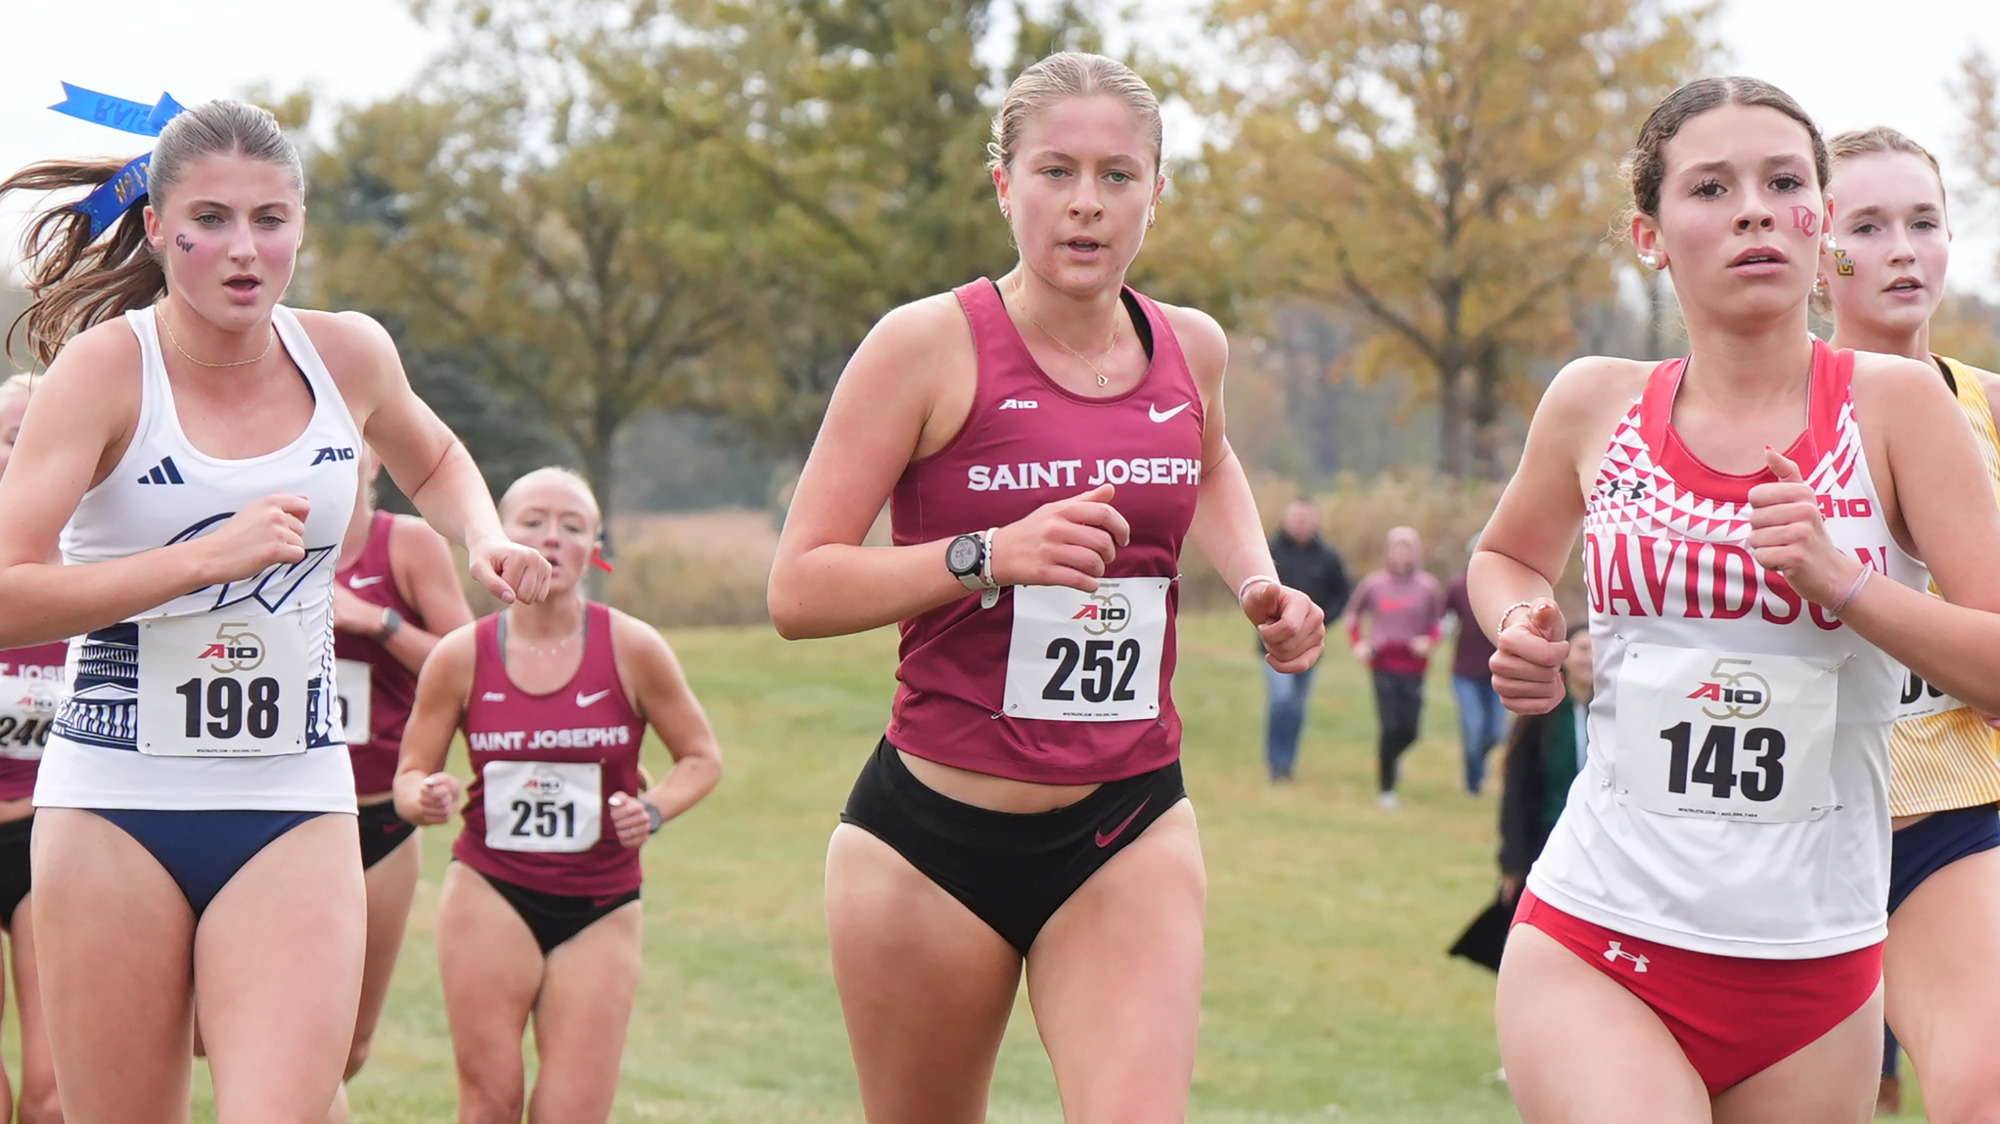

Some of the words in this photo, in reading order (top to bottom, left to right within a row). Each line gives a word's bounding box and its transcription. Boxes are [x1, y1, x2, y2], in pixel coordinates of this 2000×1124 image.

[999, 399, 1038, 410] A10
[310, 446, 355, 467] A10
[967, 459, 1082, 491] SAINT
[1088, 457, 1202, 486] JOSEPH'
[1071, 604, 1126, 620] A10
[197, 644, 258, 660] A10
[1041, 637, 1141, 703] 252
[1686, 681, 1763, 705] A10
[175, 676, 280, 740] 198
[469, 731, 526, 751] SAINT
[527, 726, 629, 749] JOSEPH'S
[1659, 720, 1787, 803] 143
[509, 799, 575, 839] 251
